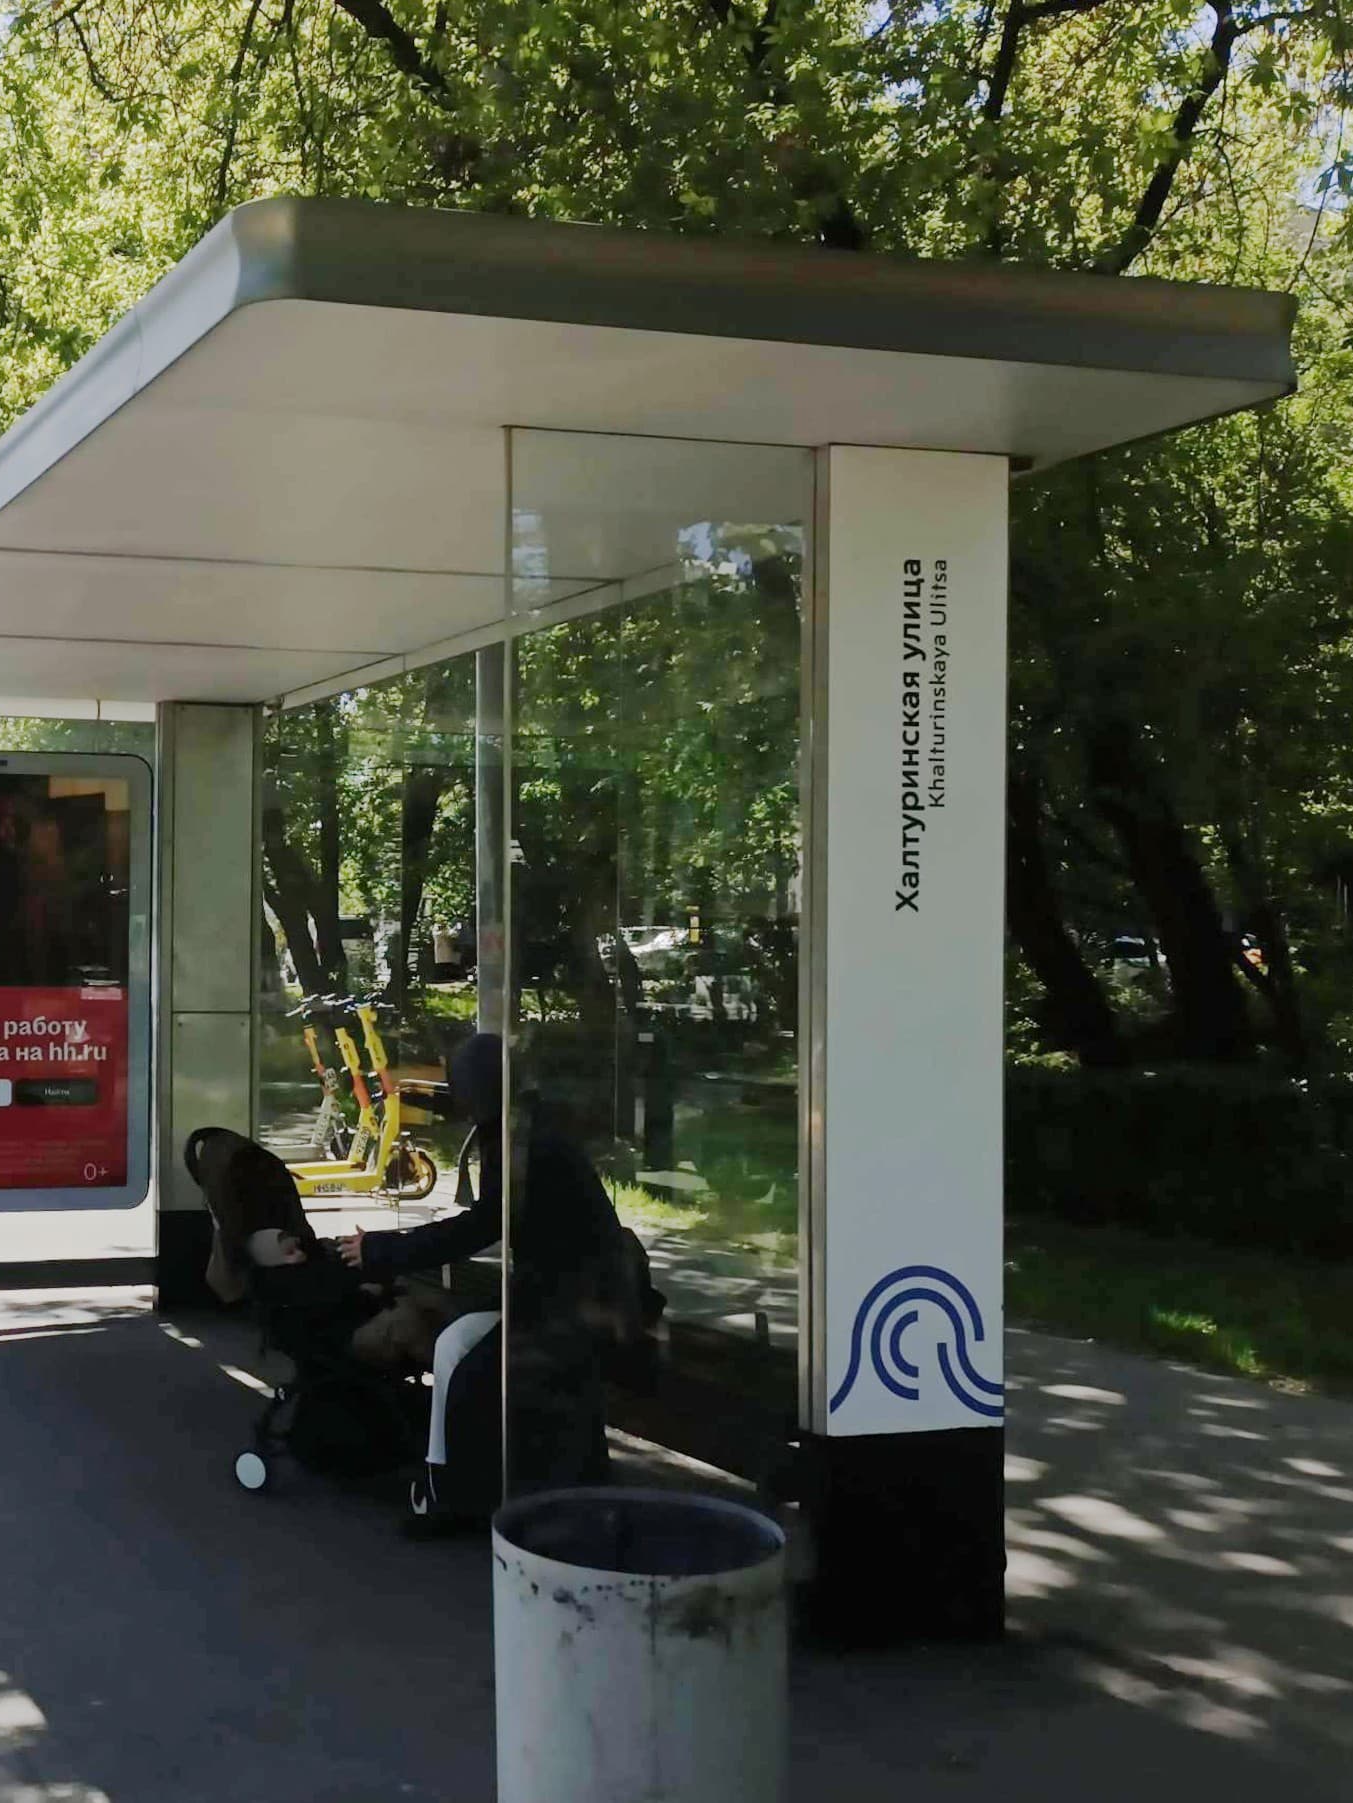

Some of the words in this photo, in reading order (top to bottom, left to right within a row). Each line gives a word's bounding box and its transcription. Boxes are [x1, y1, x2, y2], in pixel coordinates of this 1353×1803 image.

[903, 558, 926, 661] улица
[929, 558, 947, 626] Ulitsa
[928, 634, 950, 808] Khalturinskaya
[895, 670, 925, 912] Халтуринская
[4, 1016, 88, 1039] работу
[15, 1045, 43, 1061] на
[49, 1041, 107, 1062] hh.ru
[83, 1162, 109, 1181] 0+
